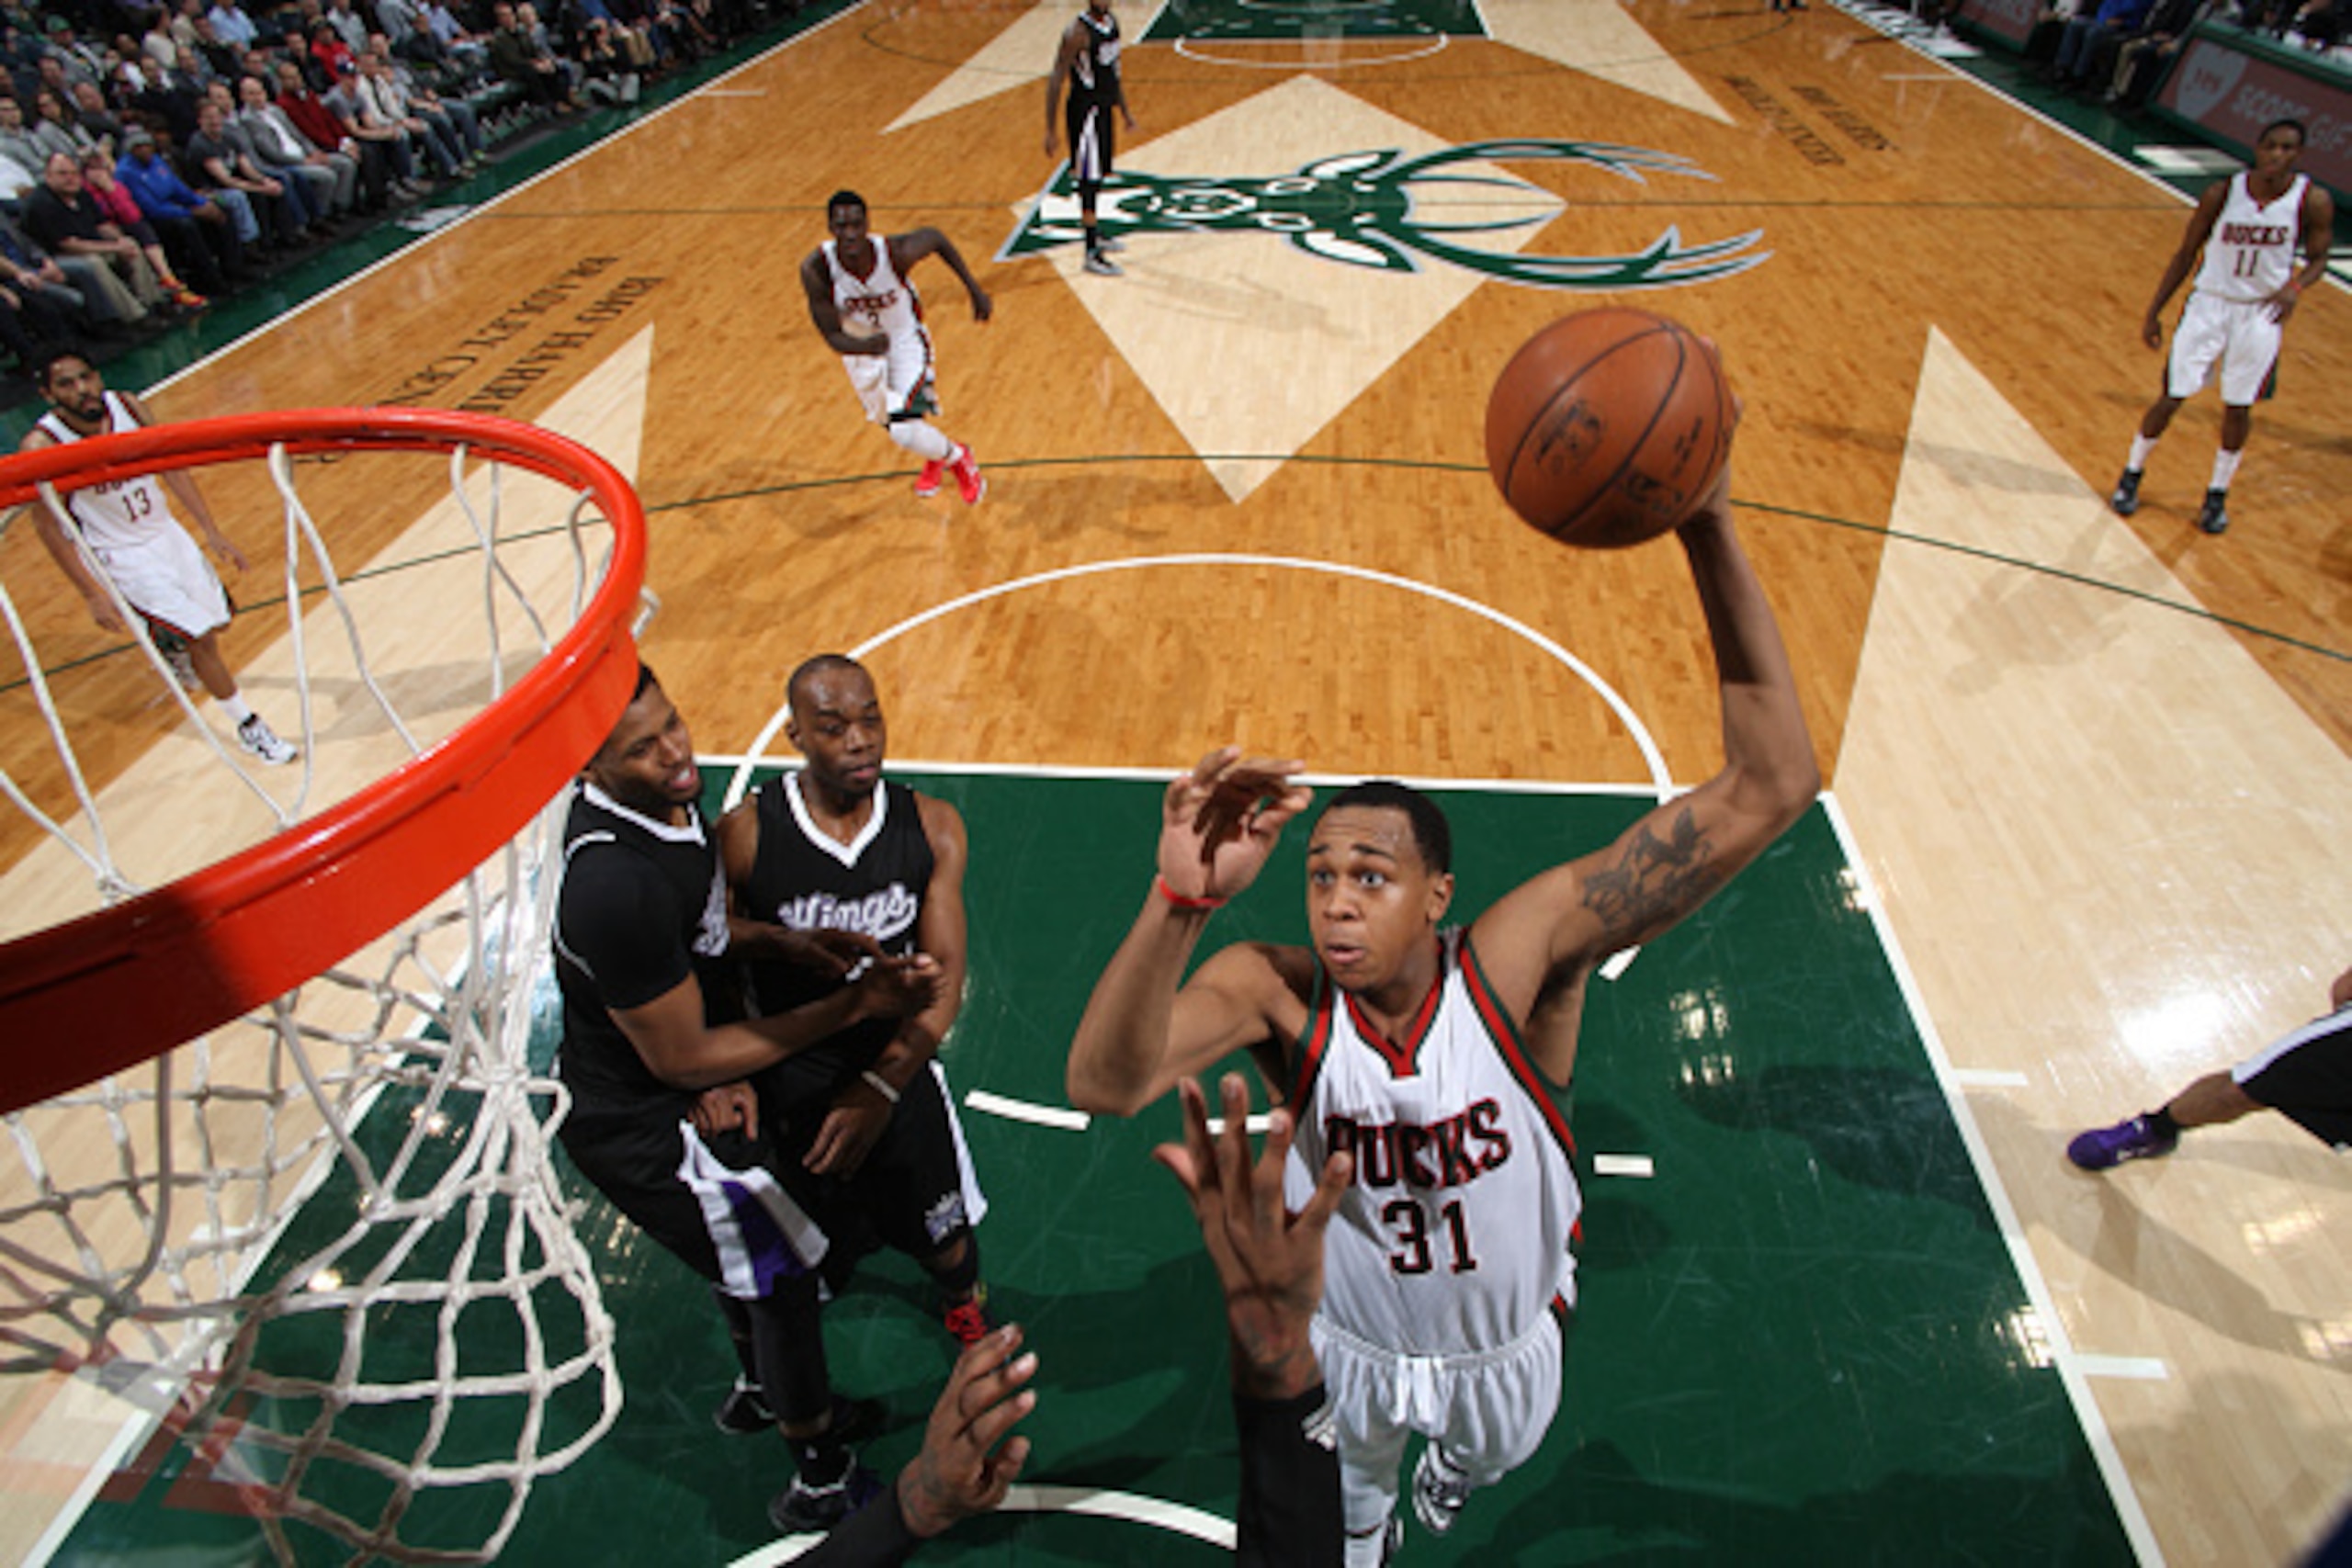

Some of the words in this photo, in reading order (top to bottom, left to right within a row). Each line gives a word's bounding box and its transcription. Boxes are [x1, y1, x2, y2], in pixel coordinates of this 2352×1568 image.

[2222, 222, 2289, 245] BUCKS
[2234, 249, 2259, 276] 11
[457, 332, 595, 409] HARRI
[122, 487, 152, 522] 13
[1324, 1098, 1512, 1189] BUCKS
[1381, 1197, 1478, 1275] 31
